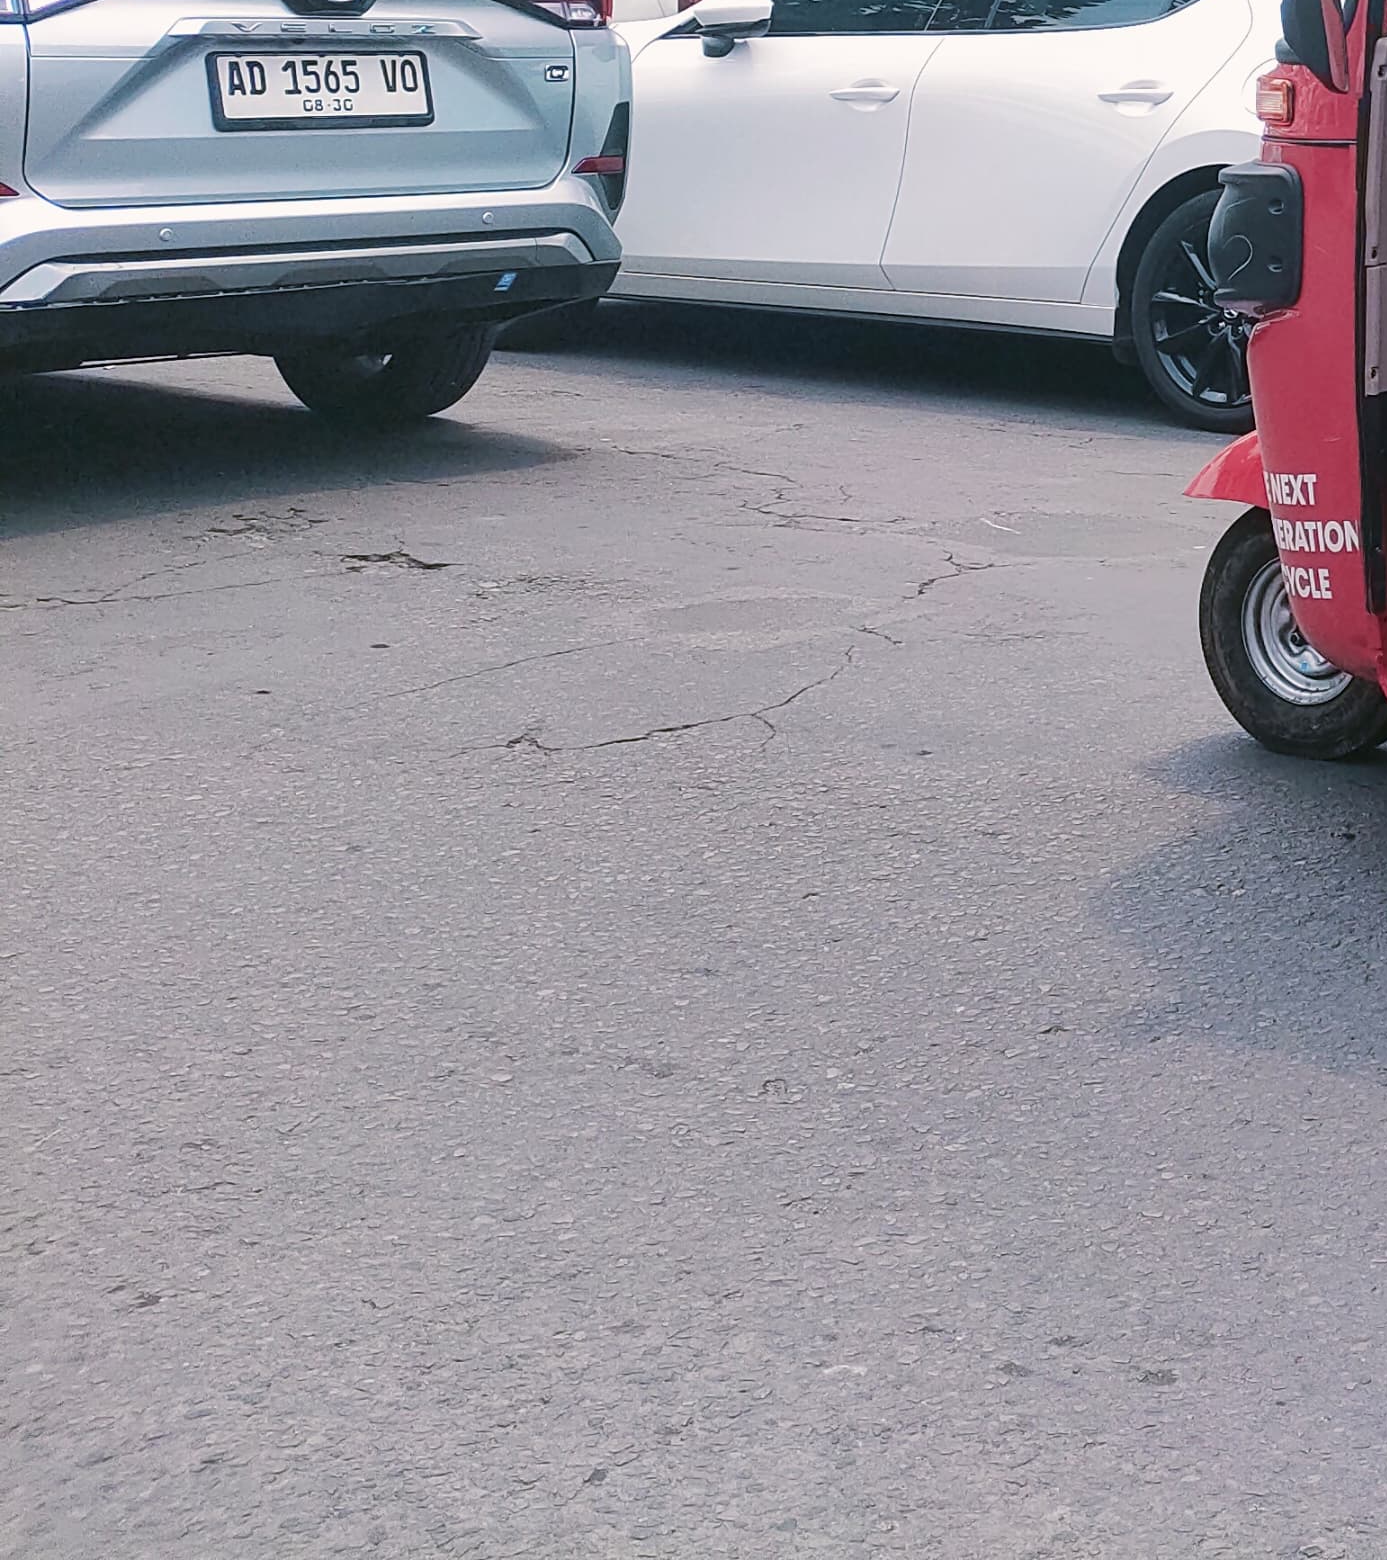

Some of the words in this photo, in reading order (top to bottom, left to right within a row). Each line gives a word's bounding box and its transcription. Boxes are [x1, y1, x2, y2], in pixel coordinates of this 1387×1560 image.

[231, 21, 437, 35] VELOZ
[228, 60, 267, 96] AD
[281, 60, 361, 96] 1565
[380, 58, 418, 93] VO
[1269, 473, 1317, 506] NEXT
